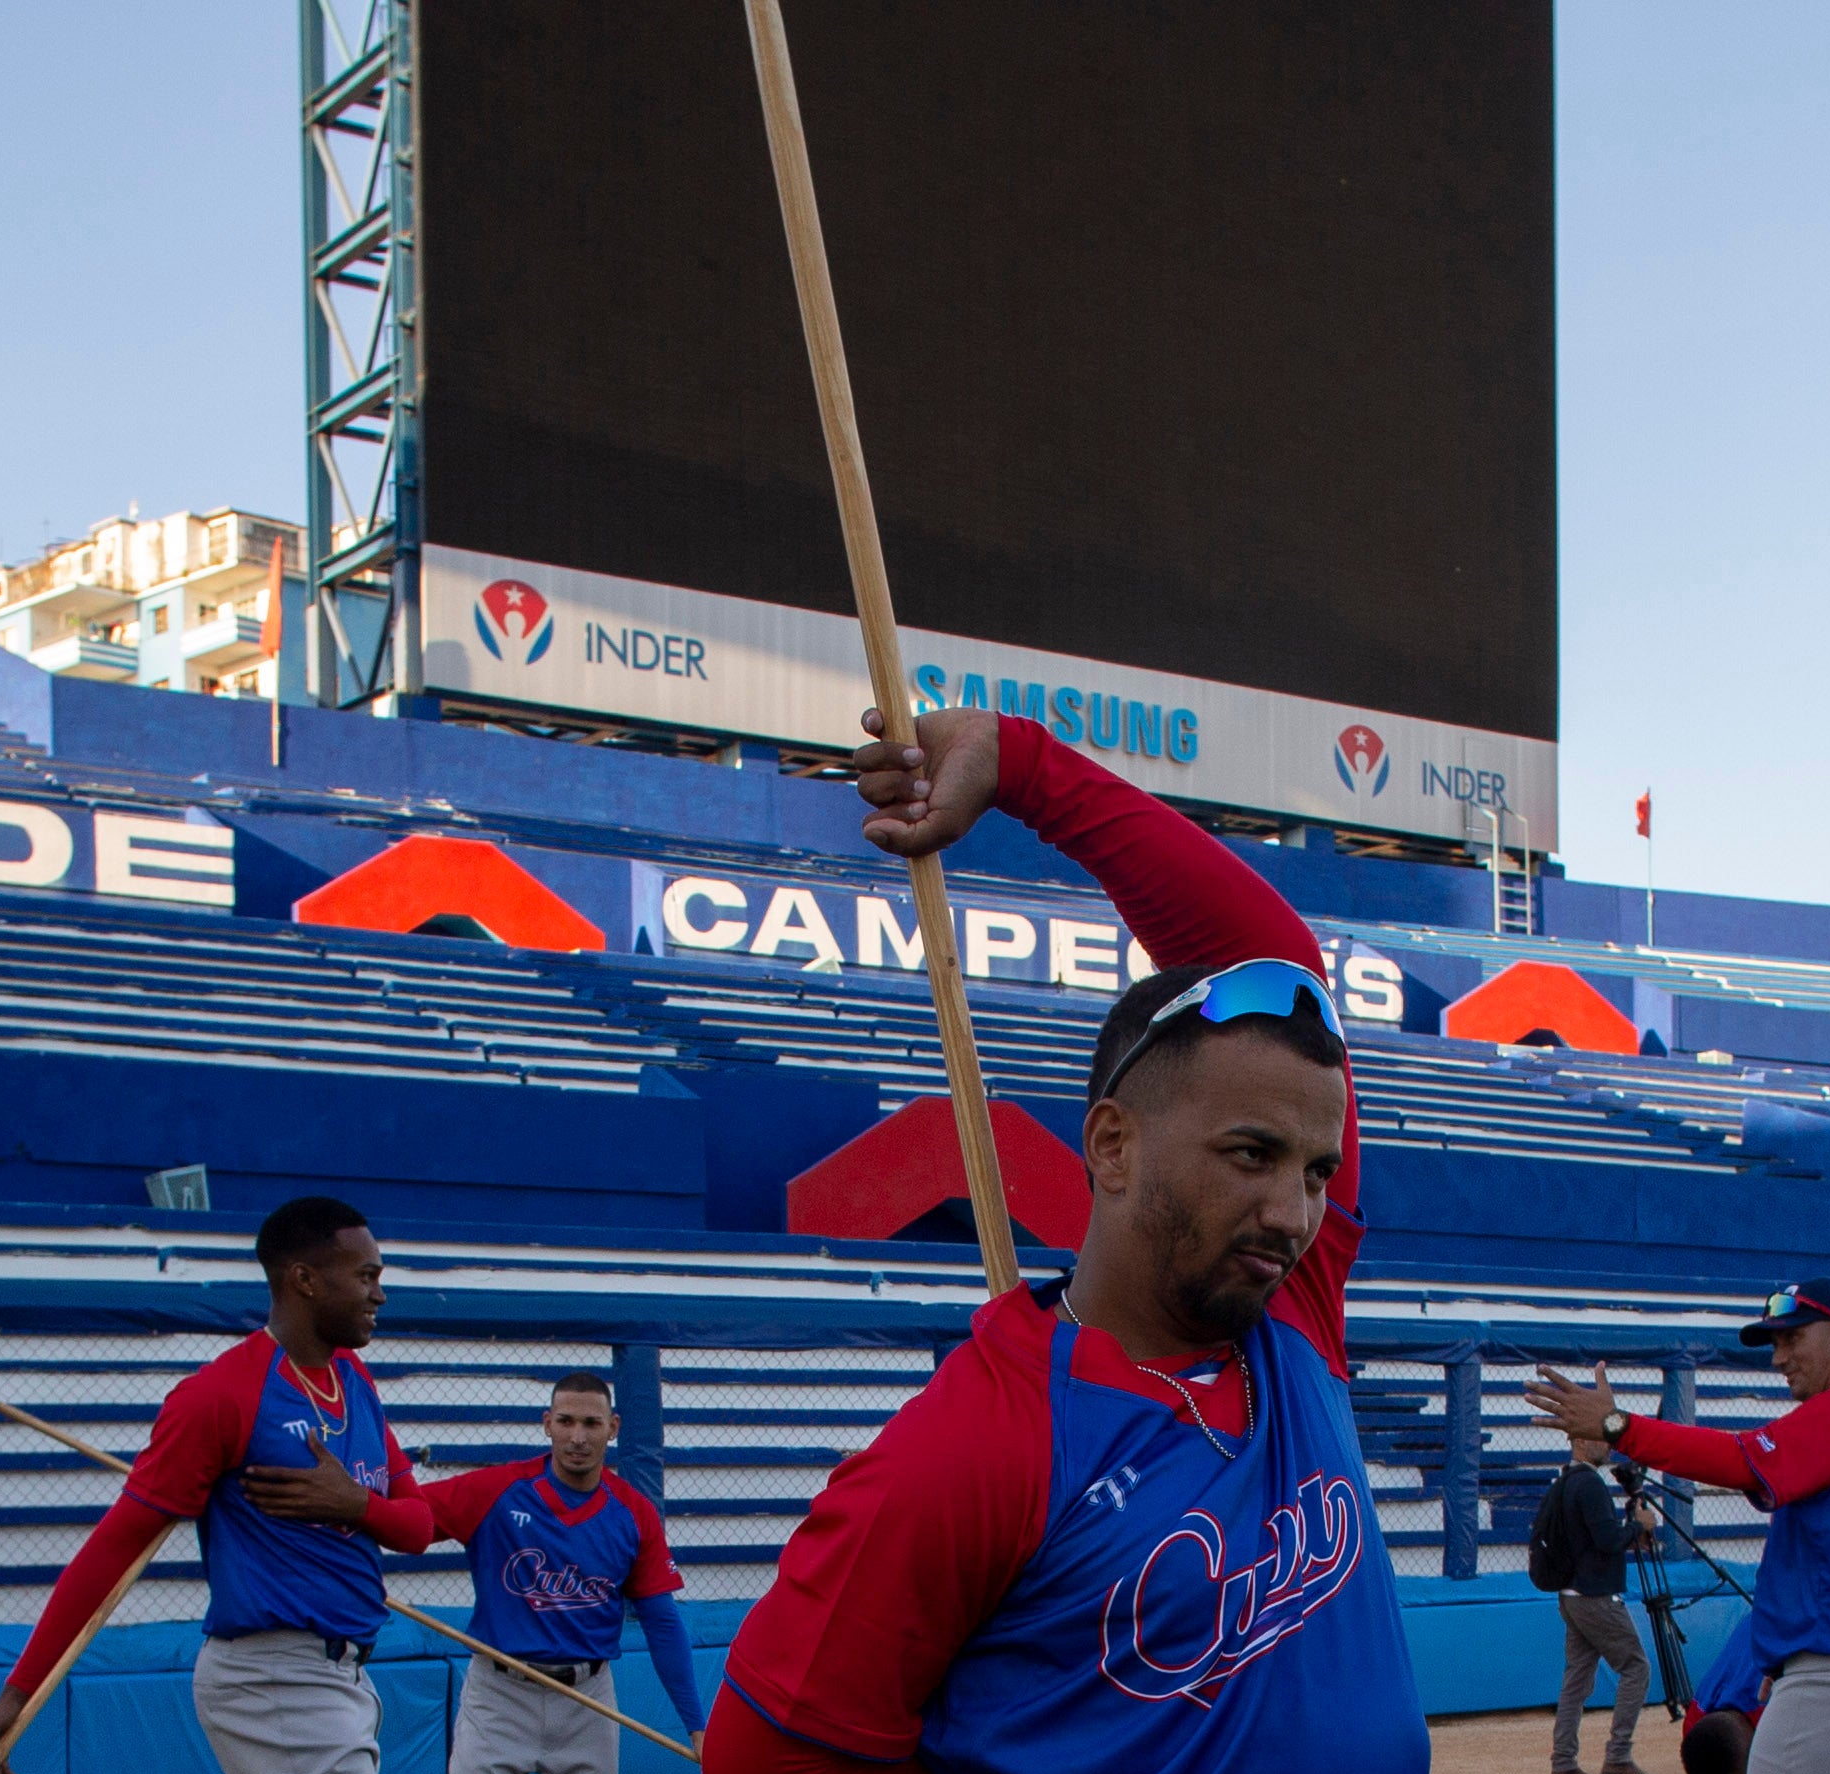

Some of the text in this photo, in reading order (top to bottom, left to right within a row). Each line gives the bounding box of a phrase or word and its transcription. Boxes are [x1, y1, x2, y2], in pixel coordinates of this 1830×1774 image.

[585, 621, 708, 681] INDER
[1421, 761, 1508, 809] INDER
[662, 876, 1405, 1023] CAMPES
